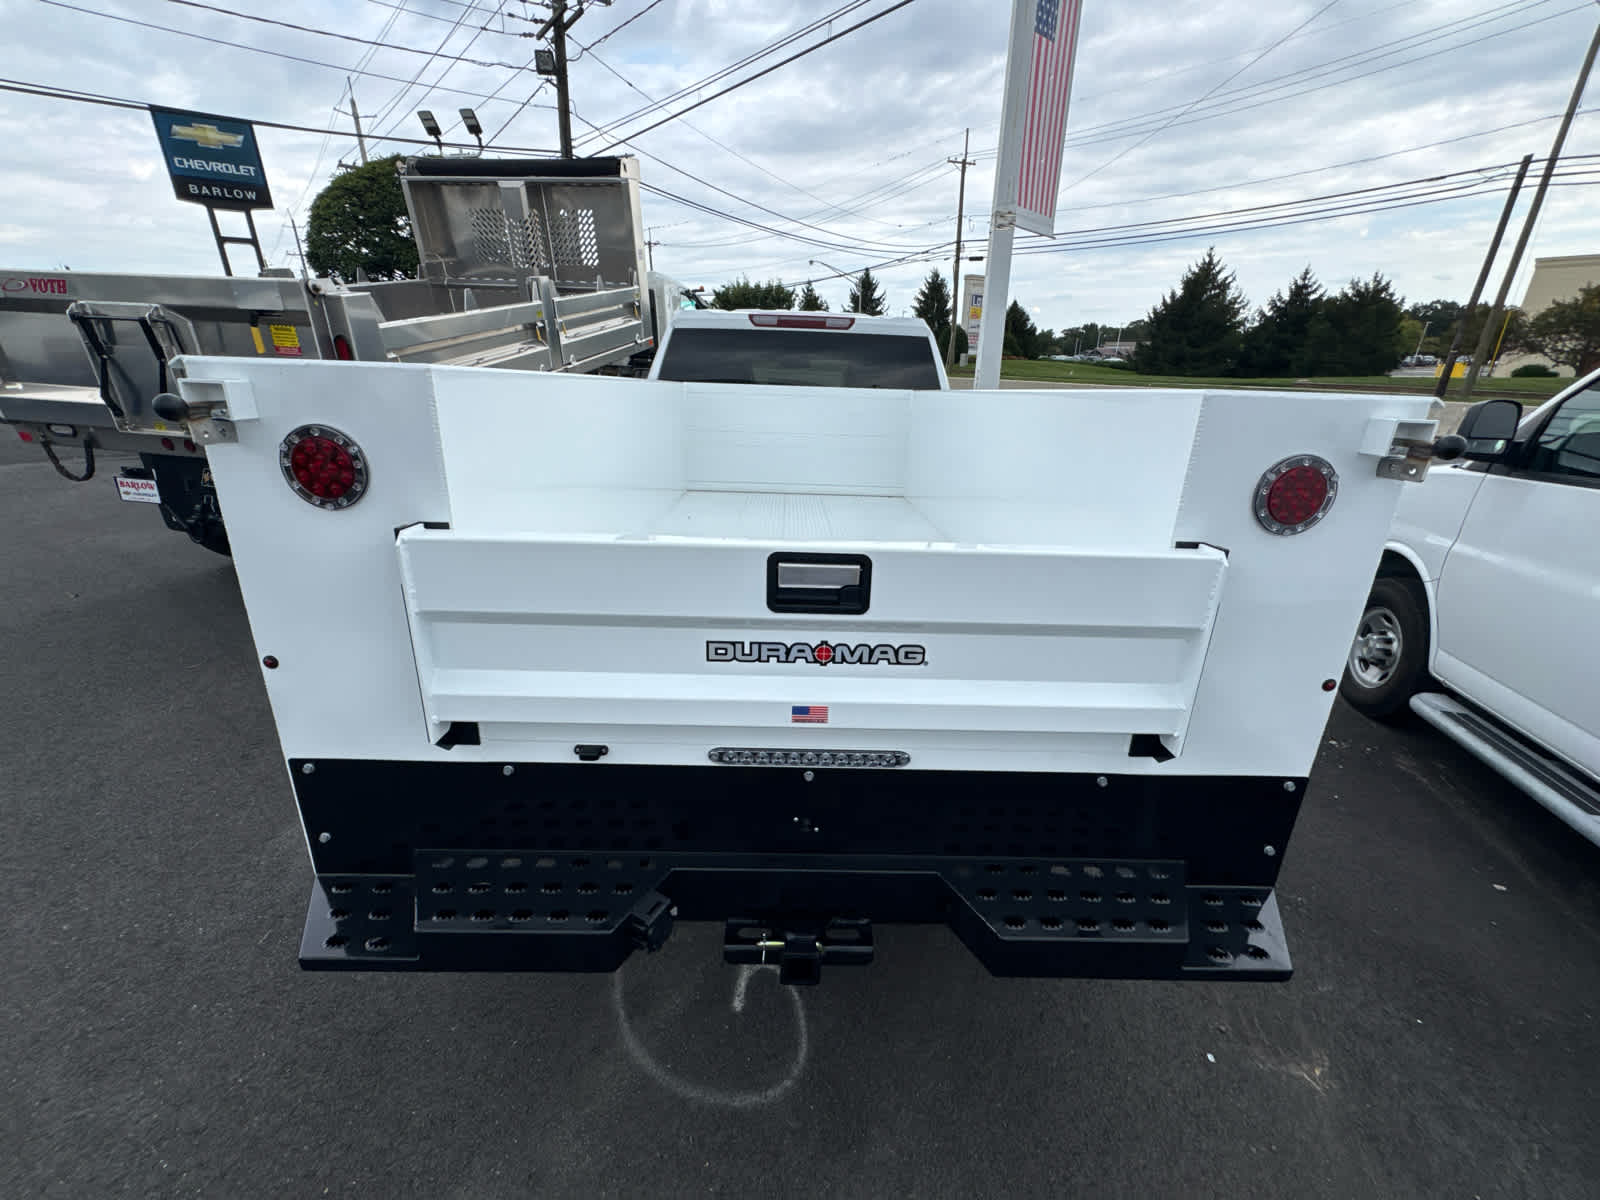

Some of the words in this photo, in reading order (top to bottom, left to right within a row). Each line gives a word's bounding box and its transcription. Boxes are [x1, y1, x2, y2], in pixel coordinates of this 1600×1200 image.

[173, 156, 256, 177] CHEVROLET
[188, 183, 257, 200] BARLOW
[29, 278, 67, 294] VOTH
